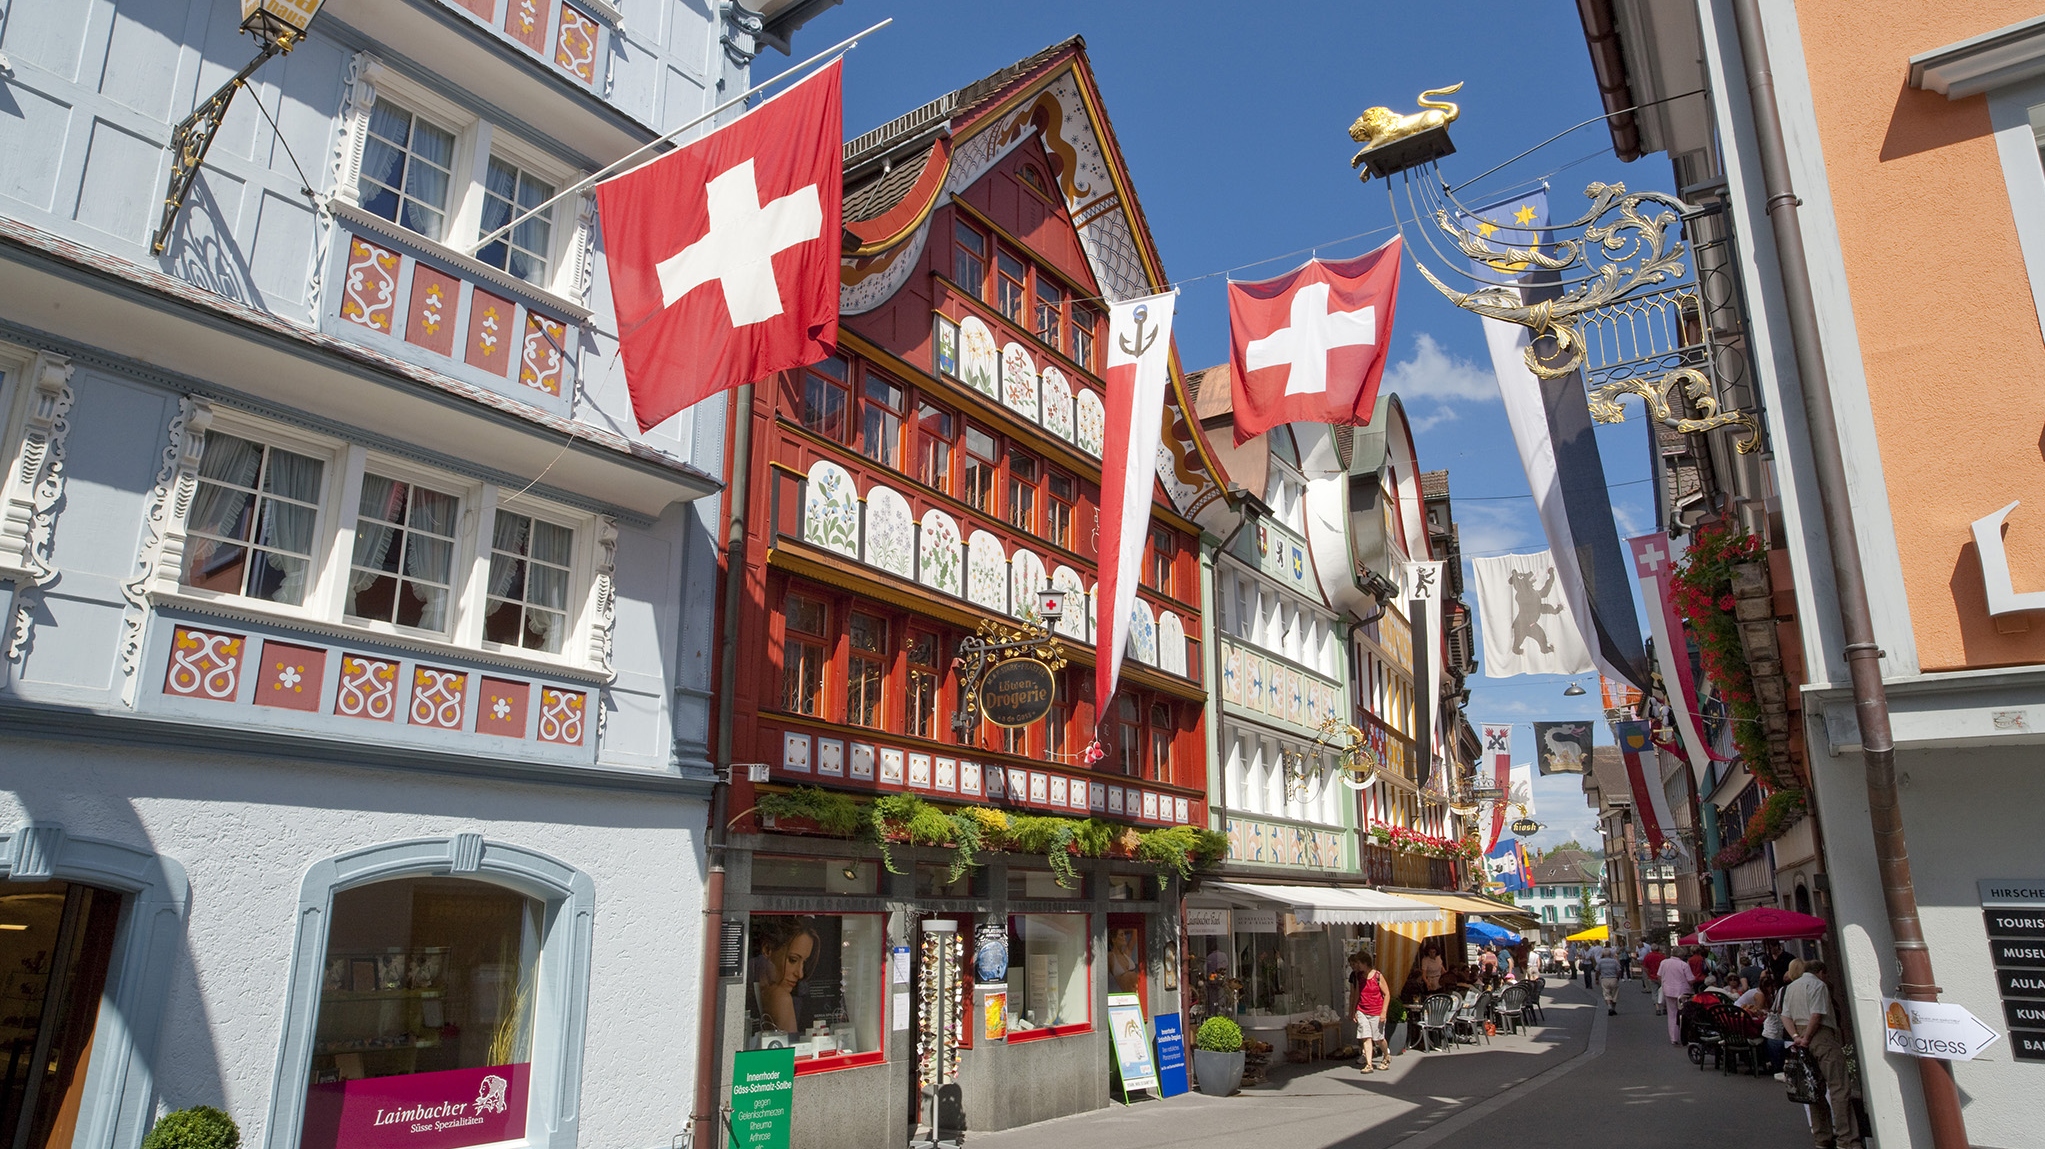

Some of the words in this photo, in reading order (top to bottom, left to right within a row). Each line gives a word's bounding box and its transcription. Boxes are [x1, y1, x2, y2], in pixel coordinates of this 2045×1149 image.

[999, 680, 1037, 692] Löwen-
[985, 685, 1047, 709] Drogerie
[1996, 918, 2045, 929] TOURIS
[1888, 1030, 1967, 1055] Kongress
[754, 1098, 771, 1109] gegen
[373, 1101, 467, 1126] Laimbacher
[738, 1108, 784, 1121] Gelenkschmerzen
[410, 1123, 433, 1133] Süsse
[434, 1116, 484, 1132] Spezialitäten
[749, 1121, 772, 1130] Rheuma
[749, 1132, 771, 1142] Arthrose
